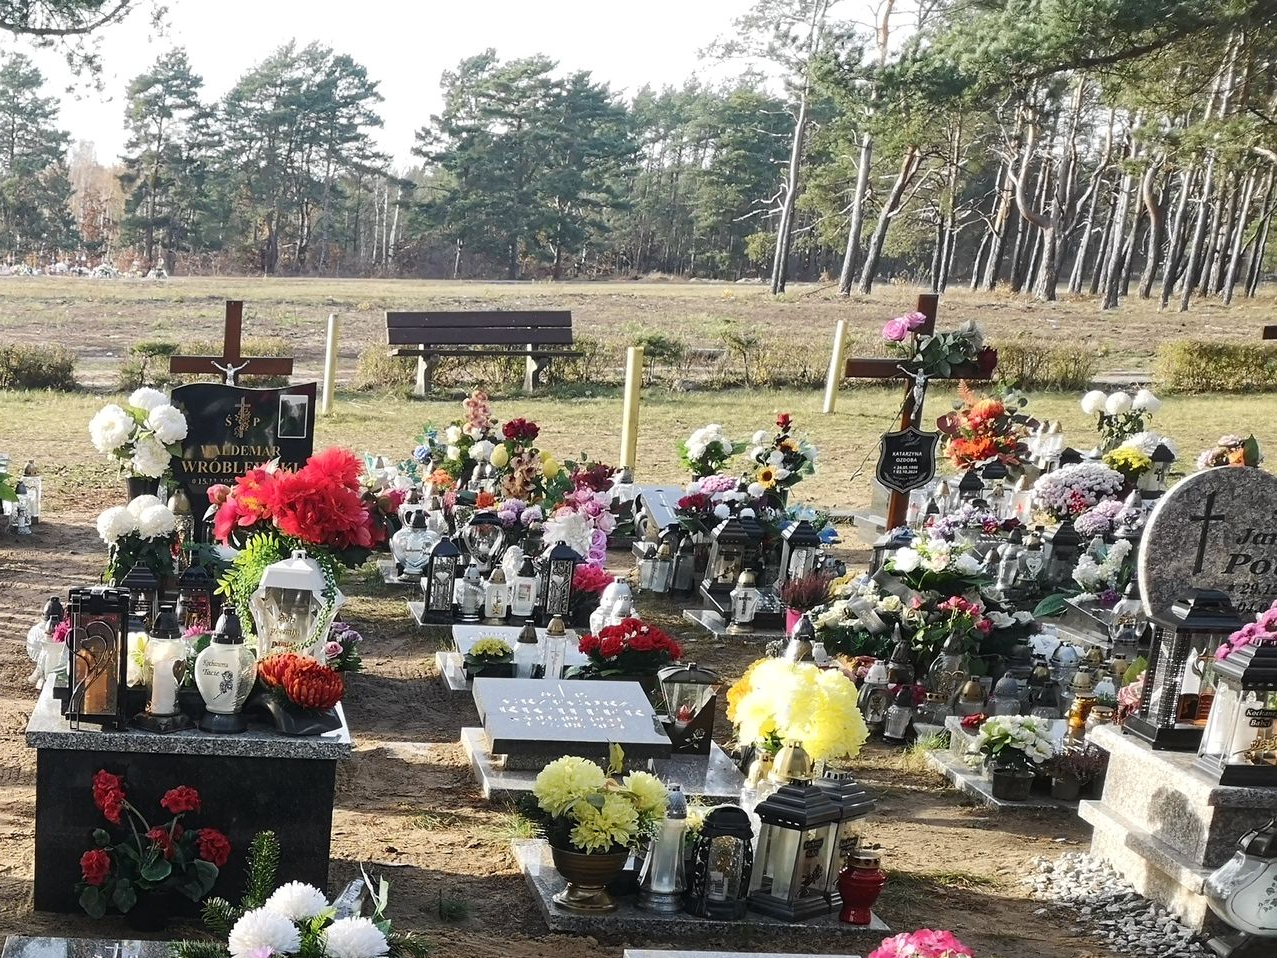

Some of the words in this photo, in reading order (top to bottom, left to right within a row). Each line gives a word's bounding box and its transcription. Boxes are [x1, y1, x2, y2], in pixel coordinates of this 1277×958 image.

[253, 417, 261, 427] P
[200, 445, 280, 456] WALDEMAR
[182, 458, 299, 474] WRÓBLEKI
